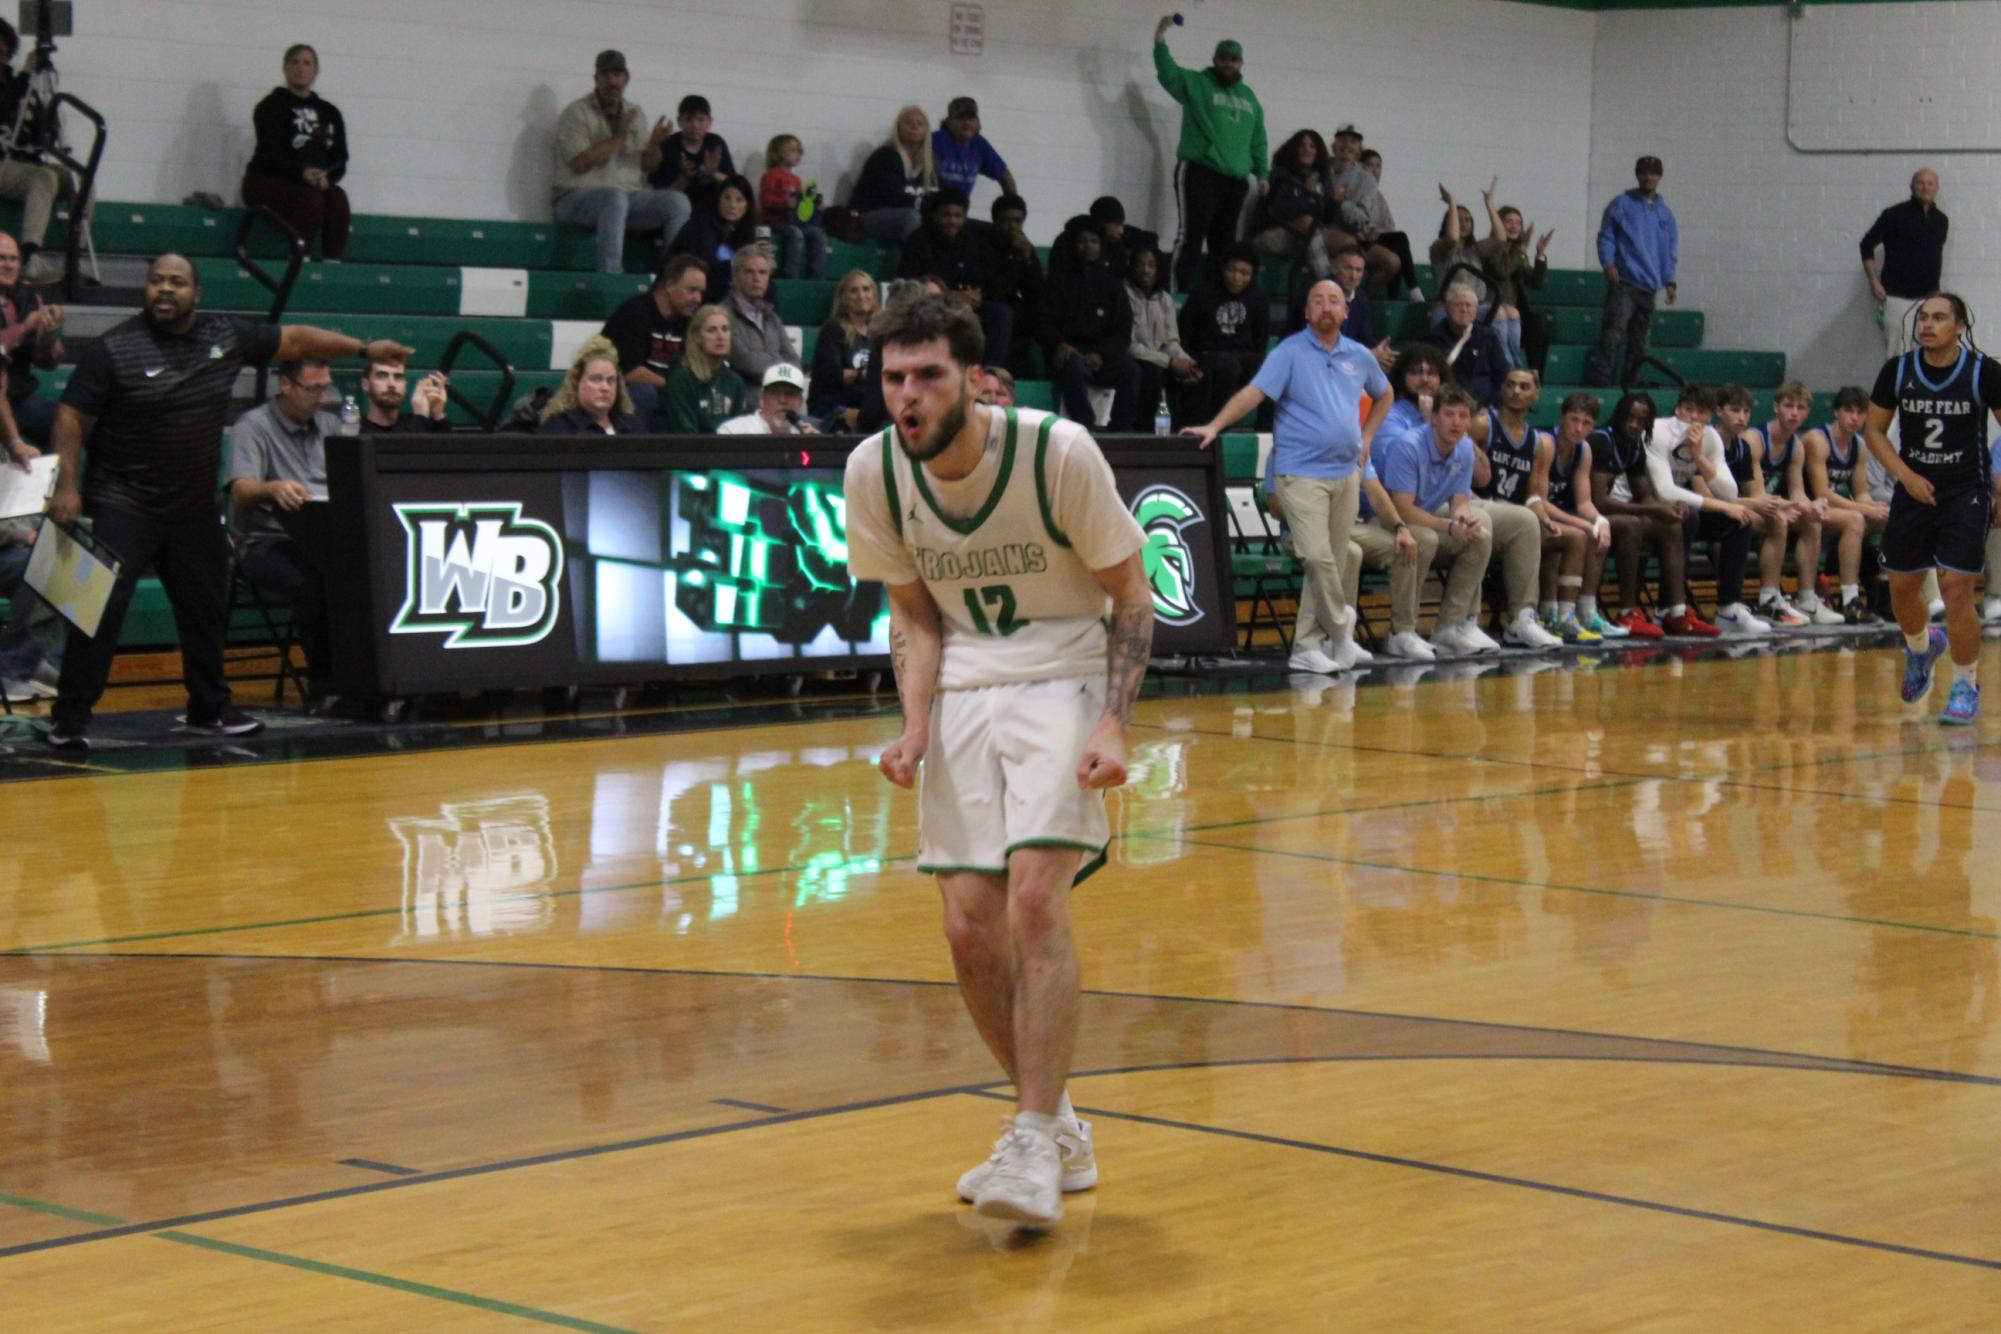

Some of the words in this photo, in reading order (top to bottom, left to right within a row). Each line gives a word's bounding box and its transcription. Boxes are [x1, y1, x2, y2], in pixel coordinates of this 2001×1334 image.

[1901, 398, 1933, 414] CAPE
[1935, 401, 1971, 415] FEAR
[1924, 418, 1944, 449] 2
[1497, 468, 1520, 499] 24
[415, 517, 553, 632] WB
[962, 584, 1031, 637] 12
